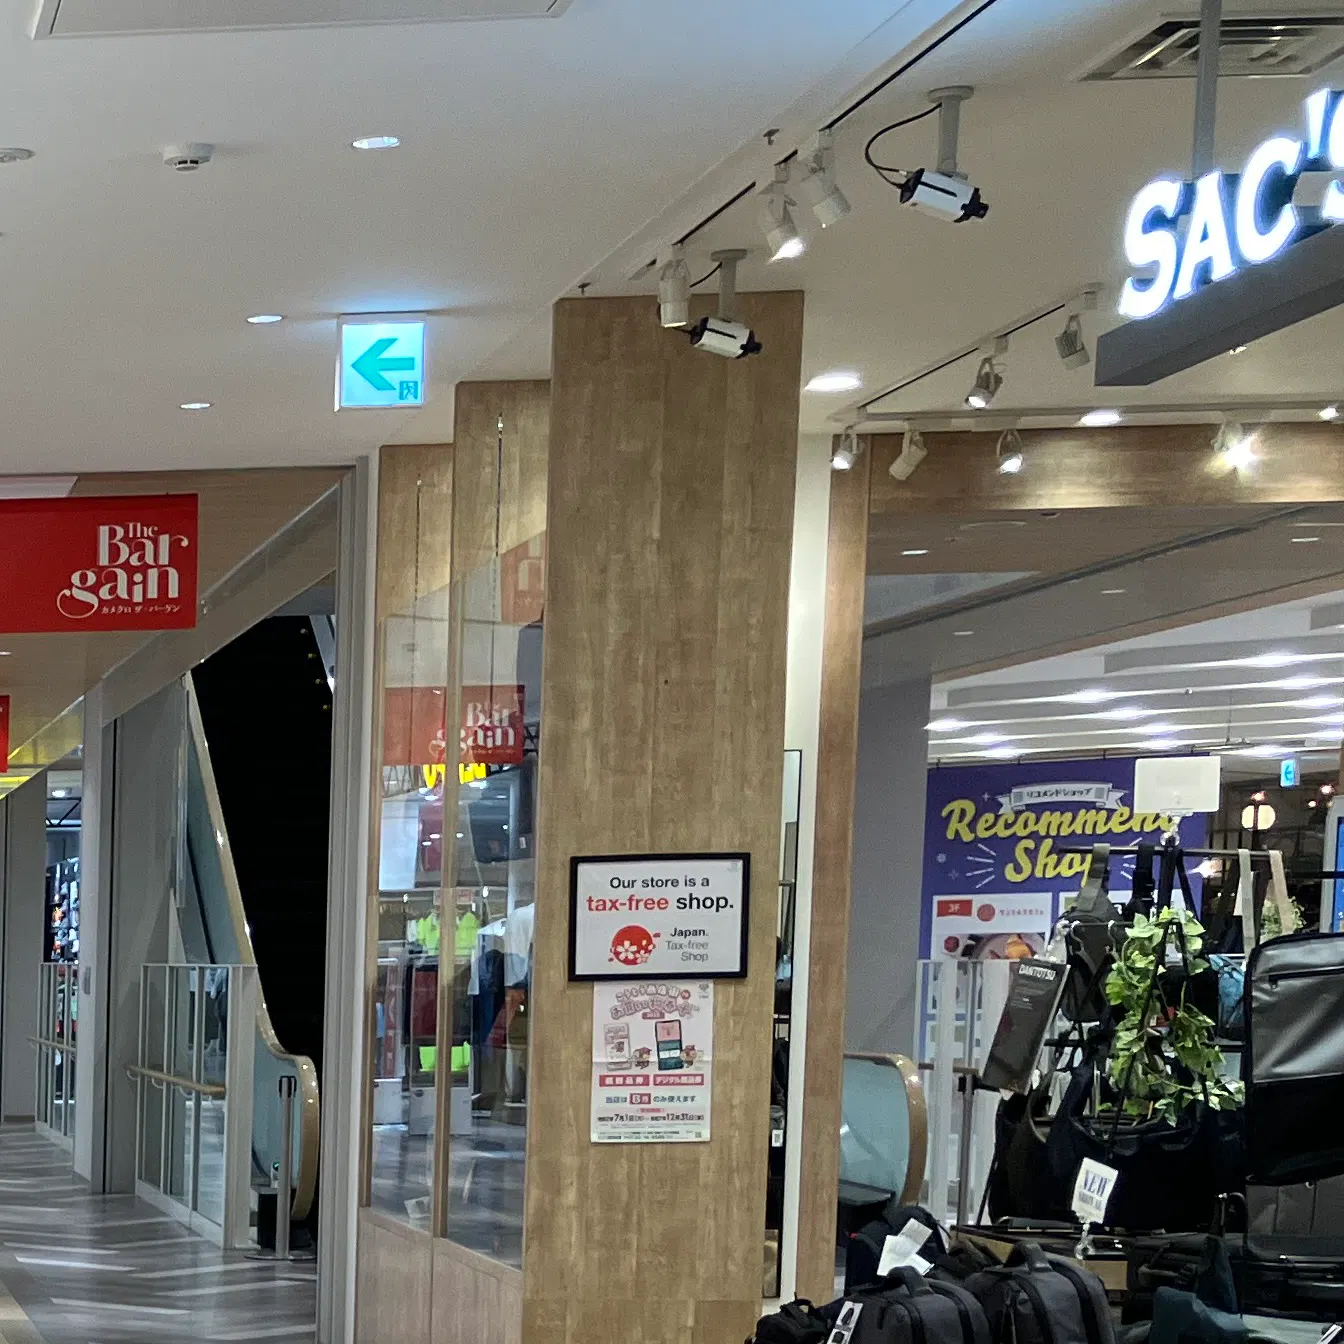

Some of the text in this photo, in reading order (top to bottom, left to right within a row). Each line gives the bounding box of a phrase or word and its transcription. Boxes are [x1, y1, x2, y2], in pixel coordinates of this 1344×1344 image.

[126, 522, 158, 538] The
[97, 525, 189, 566] Bar
[57, 567, 179, 618] gain
[610, 875, 710, 889] Our store is a
[586, 893, 734, 912] tax-free shop.
[948, 904, 961, 913] 3F
[670, 927, 709, 939] Japan.
[665, 940, 709, 950] Tax-free
[680, 951, 709, 962] Shop
[1018, 963, 1057, 981] DANTOTSU
